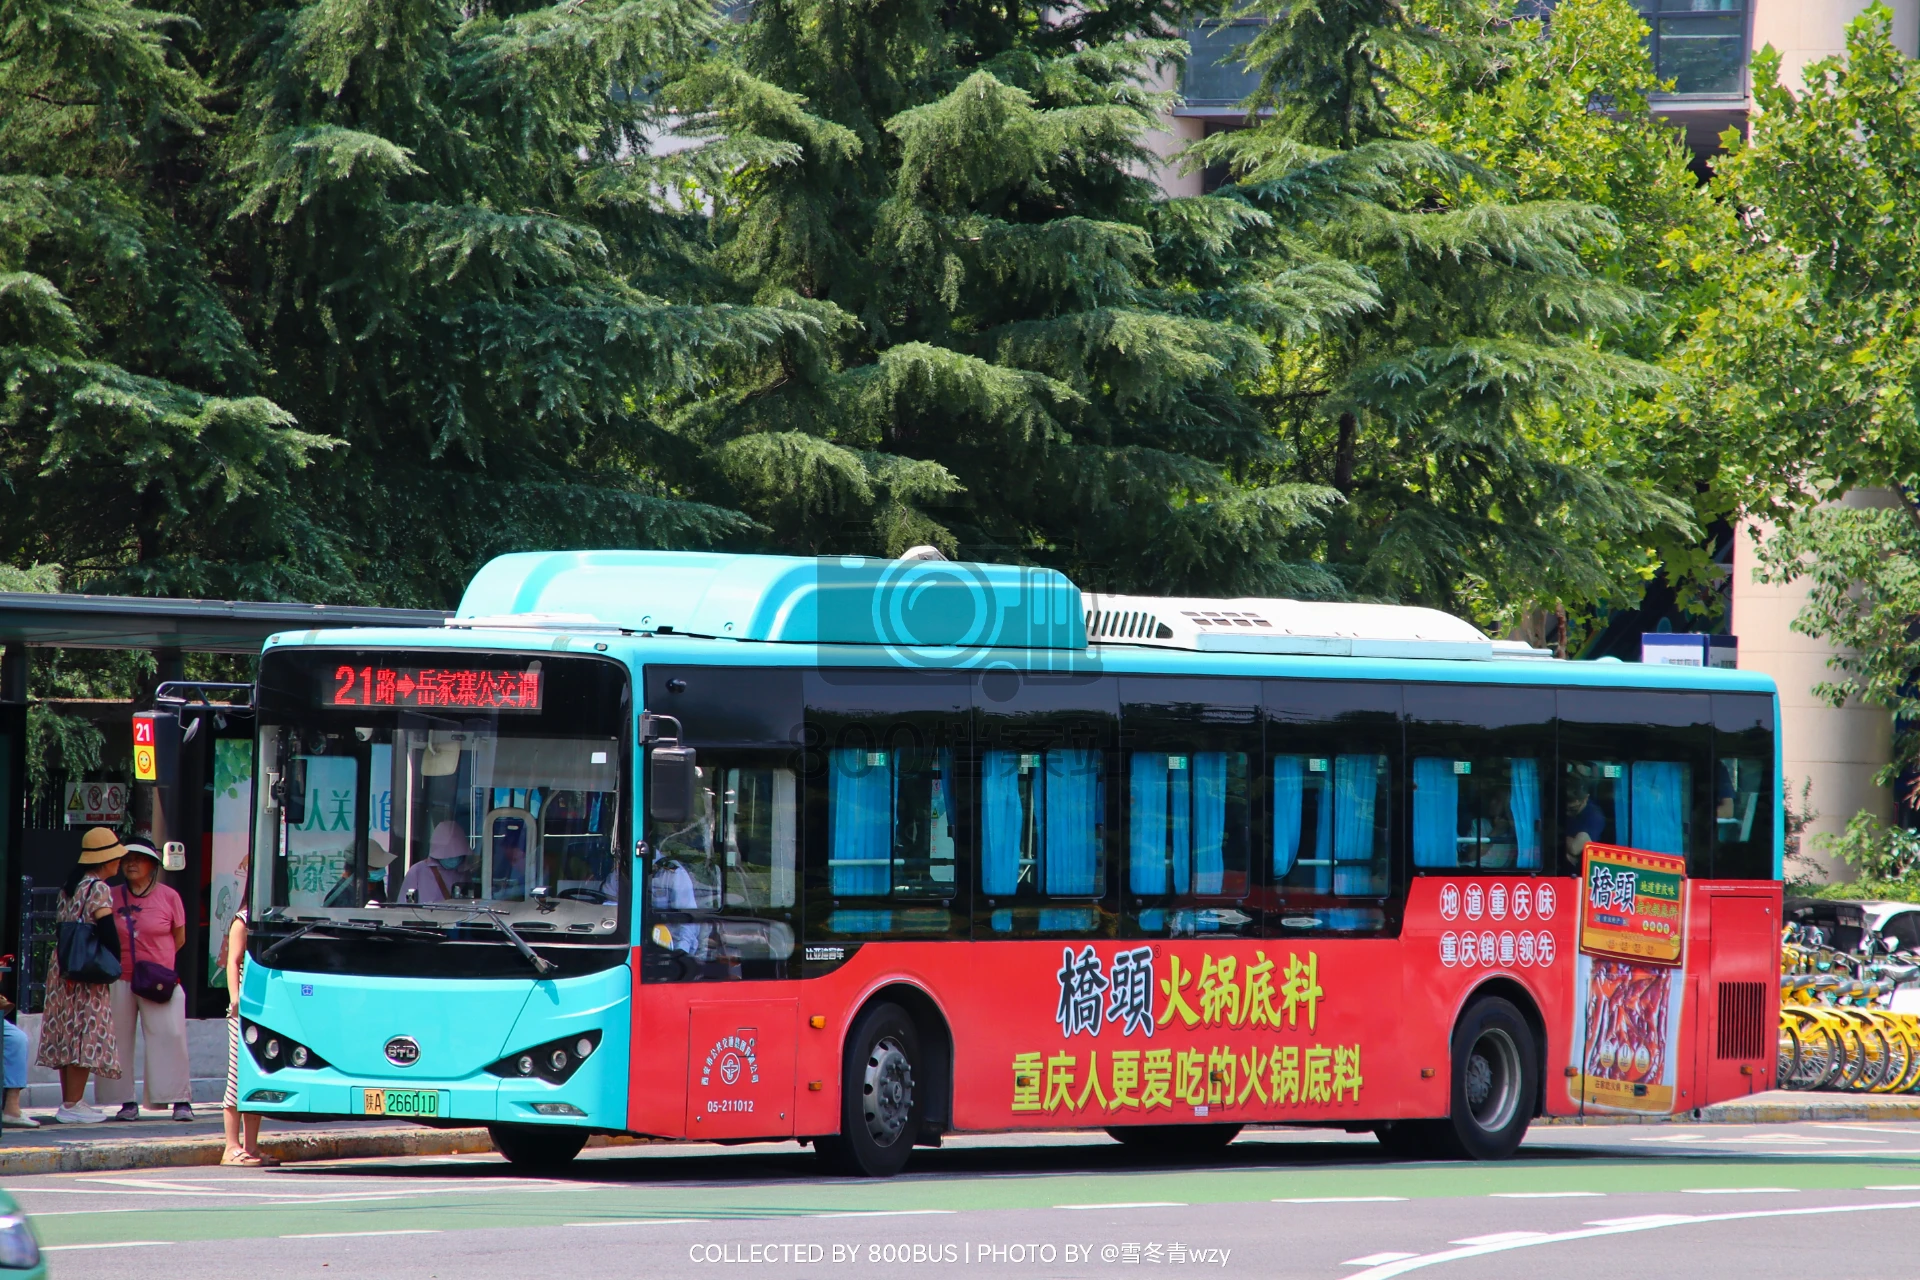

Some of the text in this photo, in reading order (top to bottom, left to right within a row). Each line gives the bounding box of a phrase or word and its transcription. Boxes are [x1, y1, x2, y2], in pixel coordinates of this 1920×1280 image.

[136, 723, 151, 742] 21
[1441, 885, 1555, 920] 地道重庆味
[1590, 866, 1636, 915] 橋頭
[1441, 932, 1555, 966] 重庆销量领先
[387, 1045, 416, 1058] BYD
[1011, 1043, 1363, 1111] 重庆人更爱吃的火锅底料
[707, 1099, 754, 1112] 05-211012
